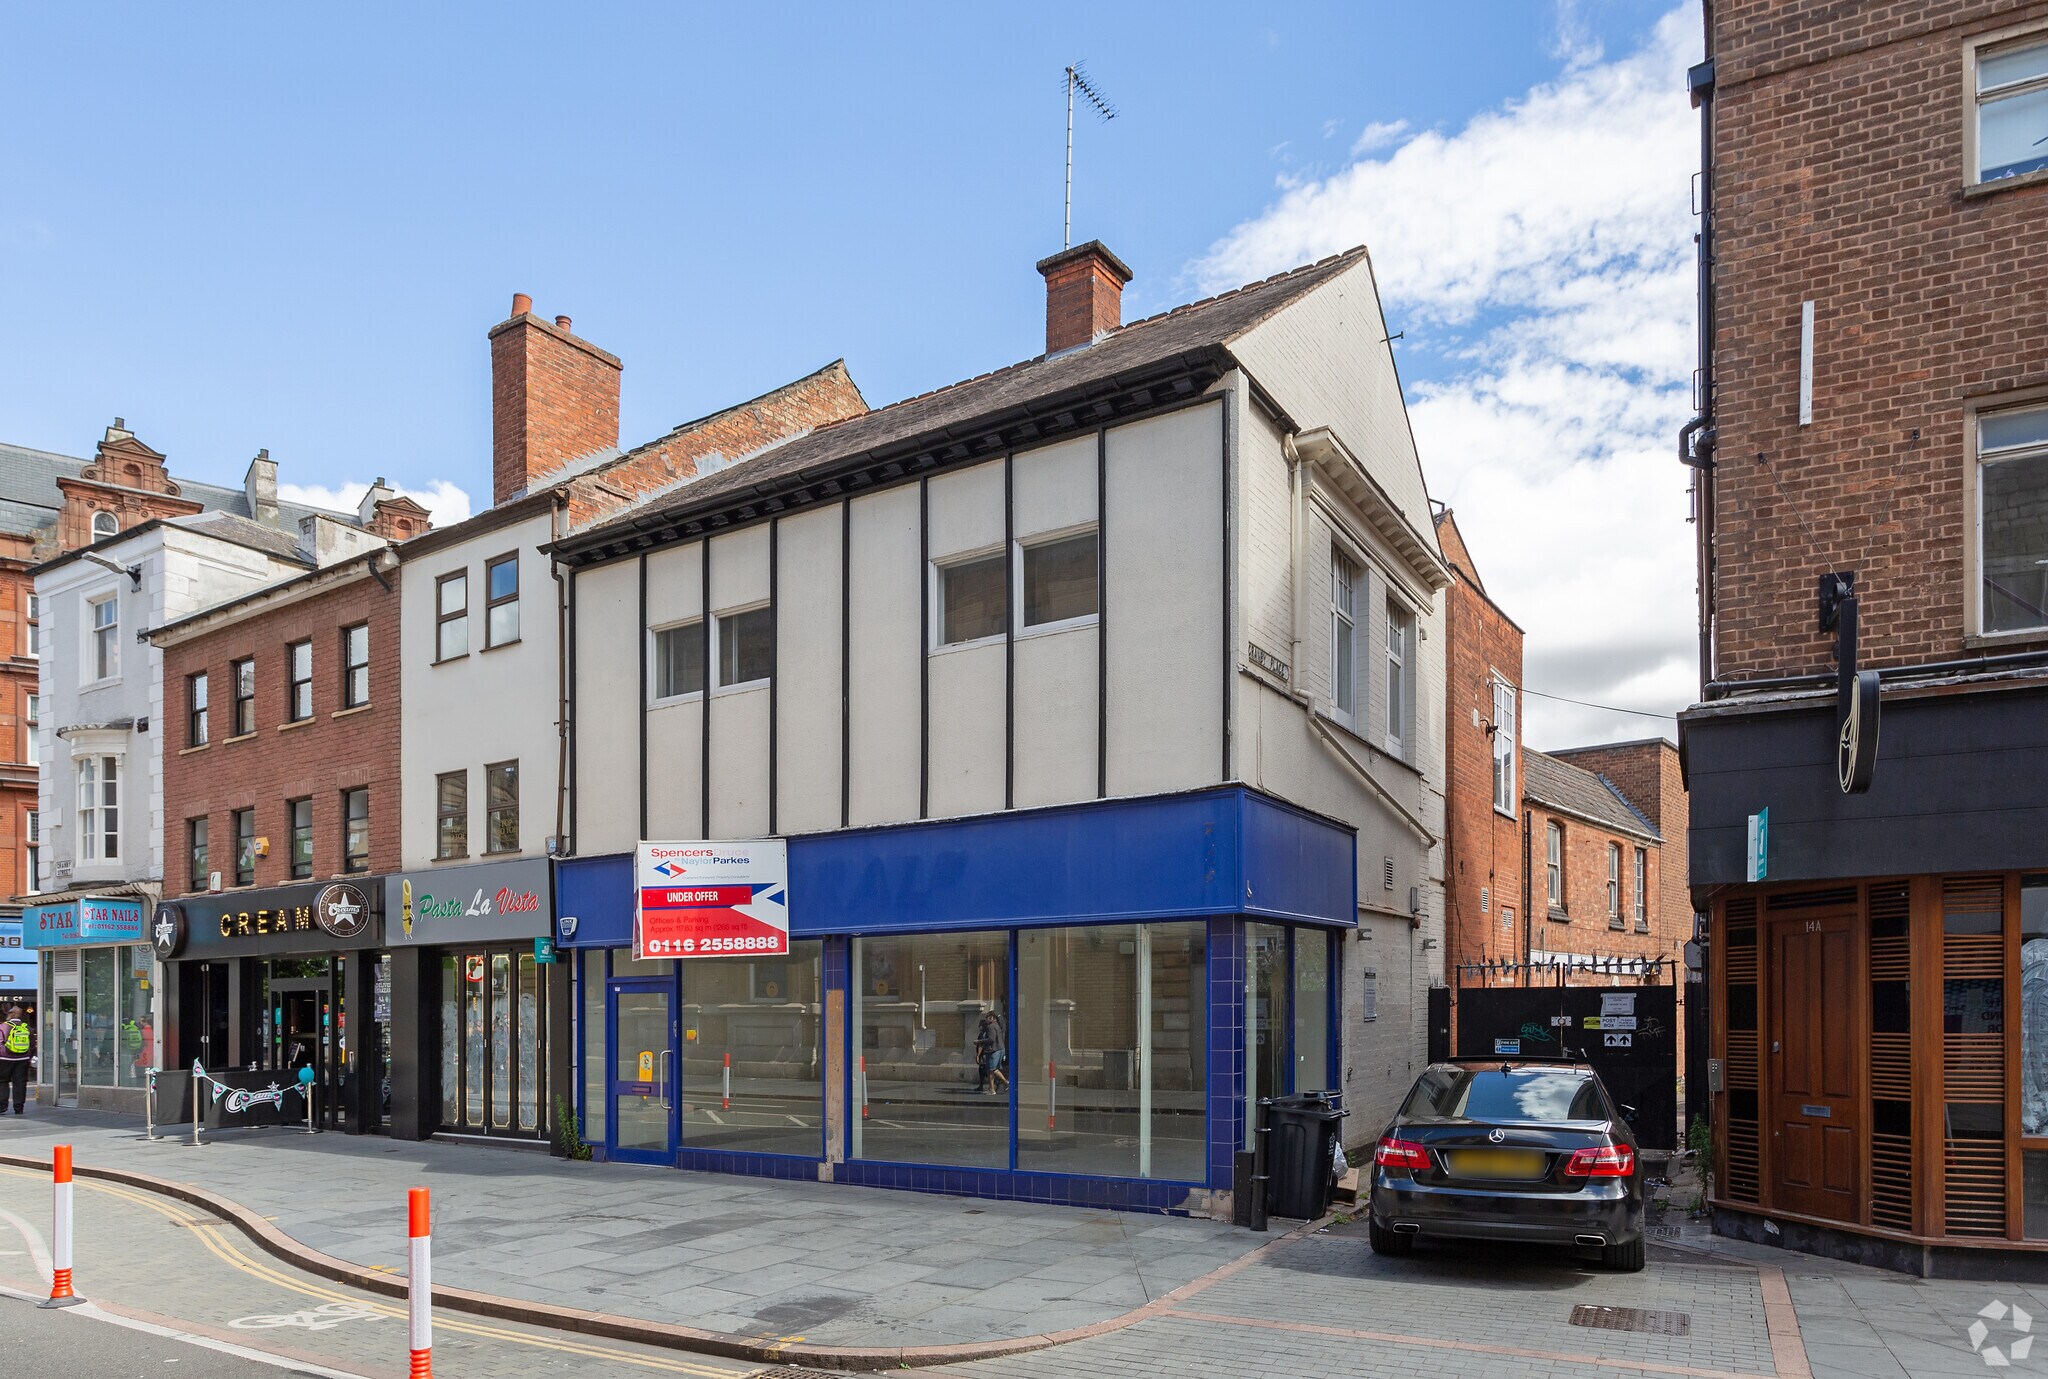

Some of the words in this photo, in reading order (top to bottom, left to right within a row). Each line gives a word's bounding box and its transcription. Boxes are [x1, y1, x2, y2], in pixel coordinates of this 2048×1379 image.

[418, 893, 464, 923] Pasta
[465, 888, 492, 917] La
[495, 886, 540, 916] Vista
[667, 892, 693, 902] UNDER
[695, 892, 718, 902] OFFER
[40, 911, 73, 930] STAR
[84, 907, 108, 921] STAR
[111, 909, 139, 922] NAILS
[220, 906, 309, 937] CREAM
[683, 916, 709, 924] Parking
[1806, 920, 1821, 932] 14A
[649, 939, 695, 953] 0116
[700, 936, 779, 951] 2558888
